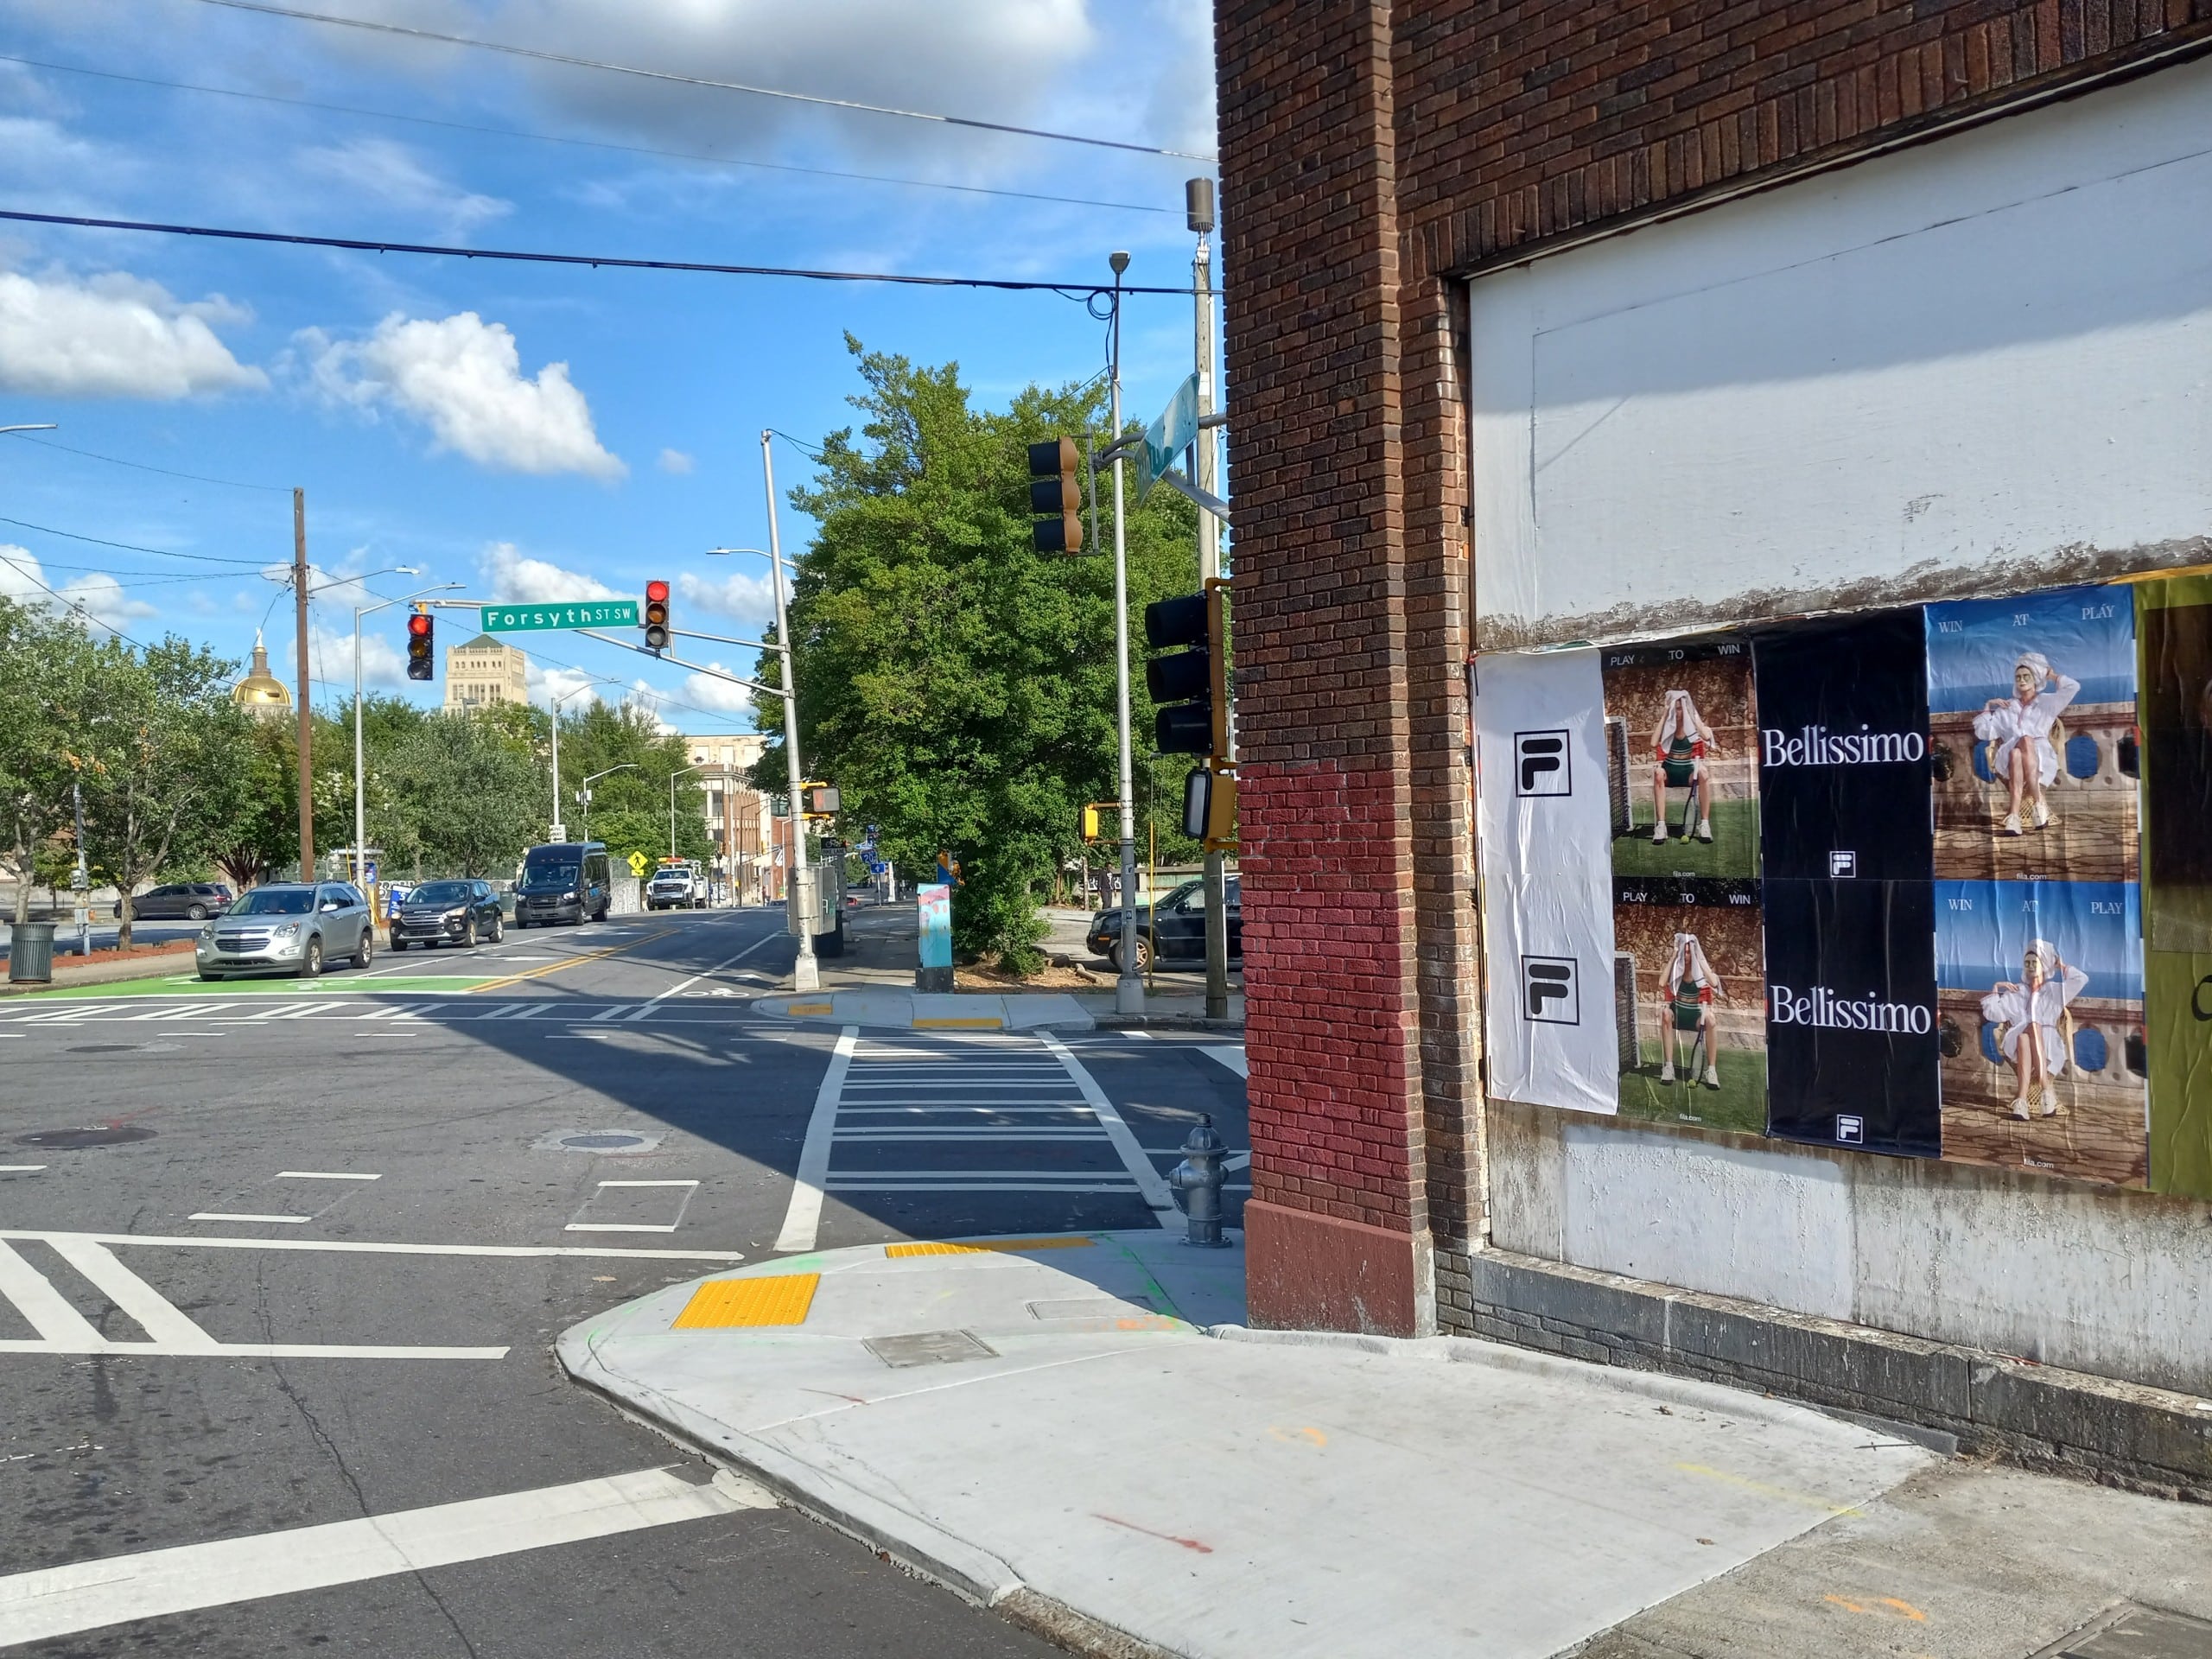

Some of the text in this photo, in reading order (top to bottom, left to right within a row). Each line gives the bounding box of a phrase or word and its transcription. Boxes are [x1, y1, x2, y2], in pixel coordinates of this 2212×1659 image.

[487, 607, 631, 626] Forsyth ST SW
[1939, 620, 1962, 632] WIN
[2012, 613, 2030, 626] AT
[1611, 644, 1740, 666] PLAY TO WIN
[1762, 723, 1924, 767] Bellissimo
[1623, 892, 1751, 905] PLAY TO WIN
[1948, 899, 2123, 914] WIN AT PLAY
[1770, 985, 1931, 1034] Bellissimo
